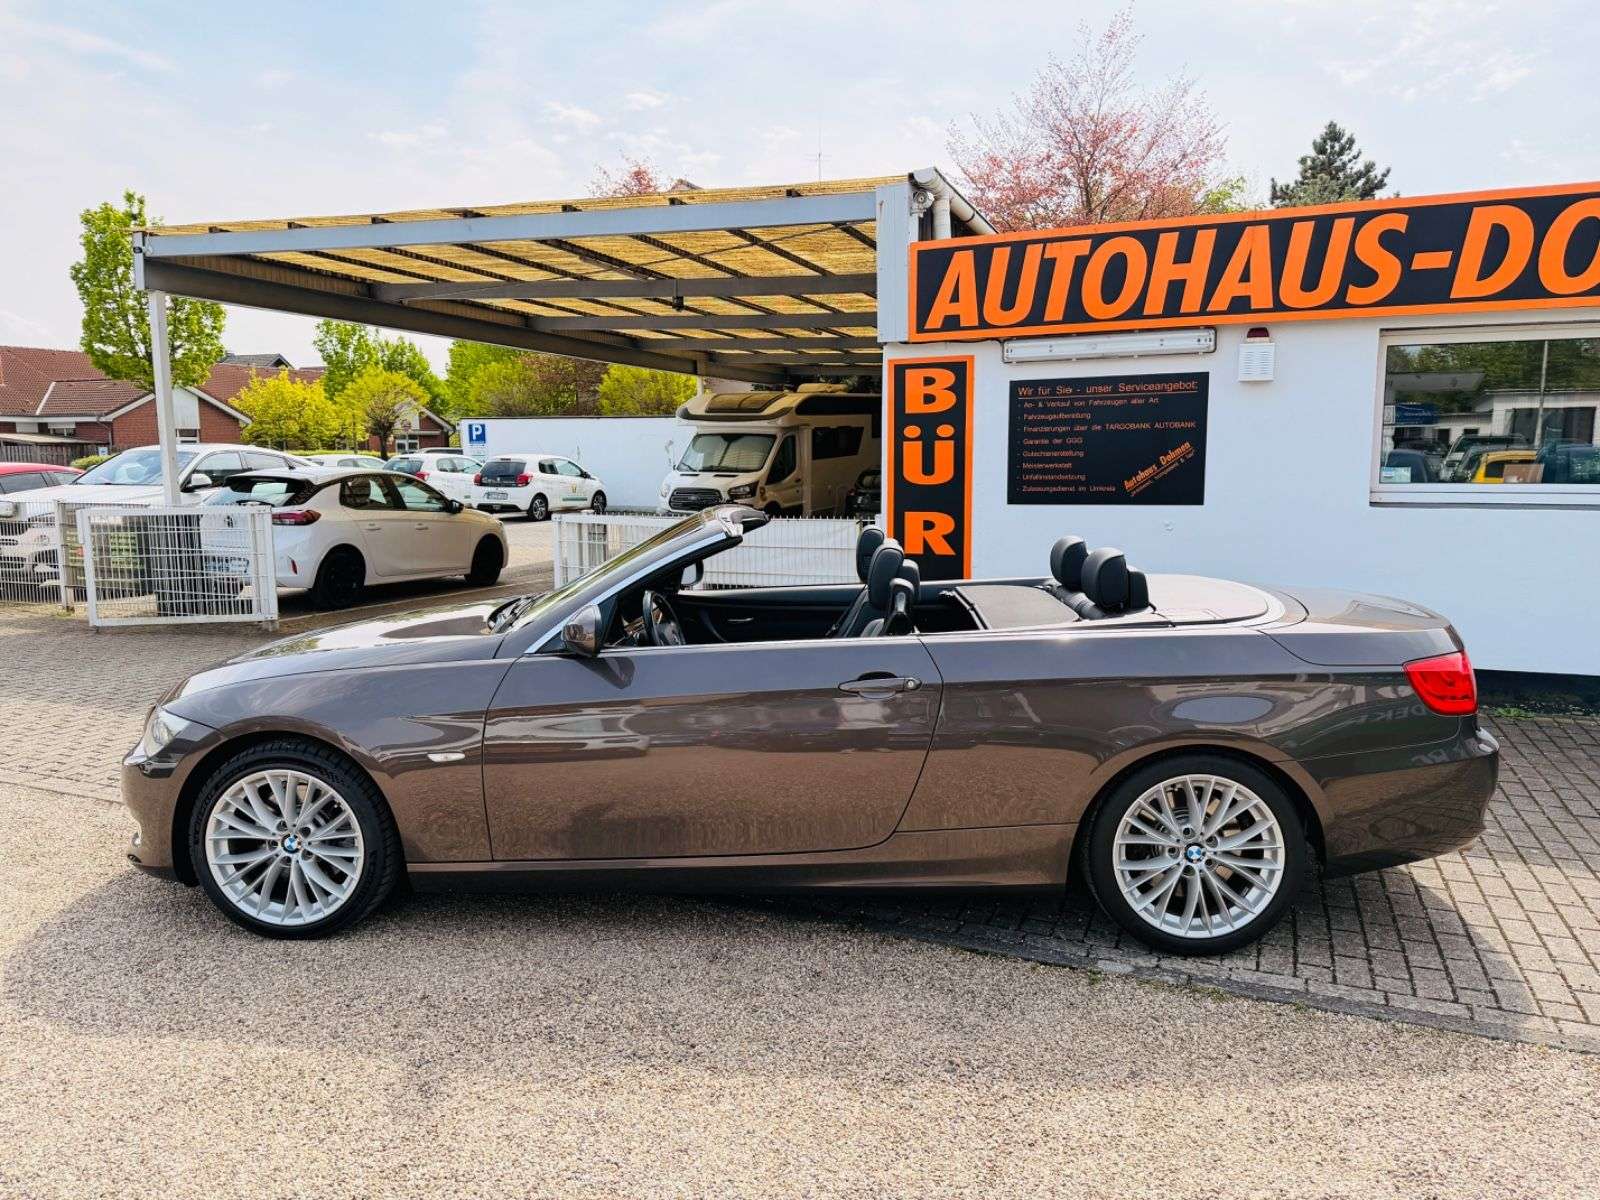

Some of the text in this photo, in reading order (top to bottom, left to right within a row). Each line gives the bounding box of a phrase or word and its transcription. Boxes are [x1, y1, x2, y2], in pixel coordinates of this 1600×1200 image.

[1017, 386, 1034, 396] Wir
[1038, 386, 1051, 396] für
[1055, 385, 1073, 395] Sie
[1086, 384, 1113, 394] unser
[1118, 380, 1199, 393] Serviceangebot:
[472, 423, 483, 441] P
